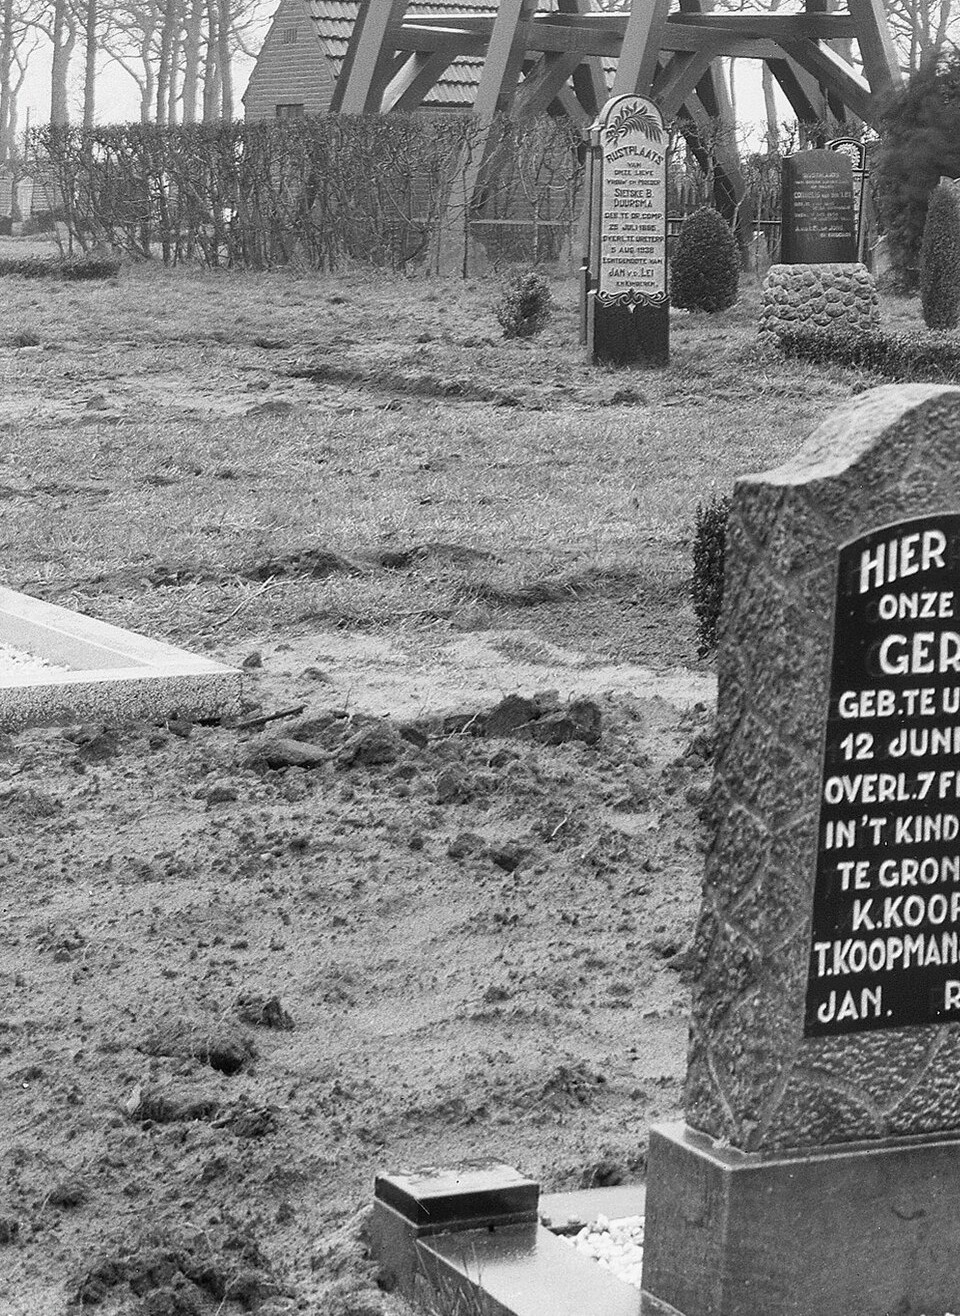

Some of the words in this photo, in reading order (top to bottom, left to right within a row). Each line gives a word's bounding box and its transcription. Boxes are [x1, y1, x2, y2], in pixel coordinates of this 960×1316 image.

[605, 145, 664, 165] RUSTPLAATS
[614, 188, 644, 198] SIETSKE
[614, 198, 653, 208] DUURSMA
[859, 530, 947, 594] HIER
[878, 591, 954, 620] ONZE
[840, 732, 875, 760] 12
[836, 861, 871, 891] TE
[817, 986, 893, 1023] JAN.
